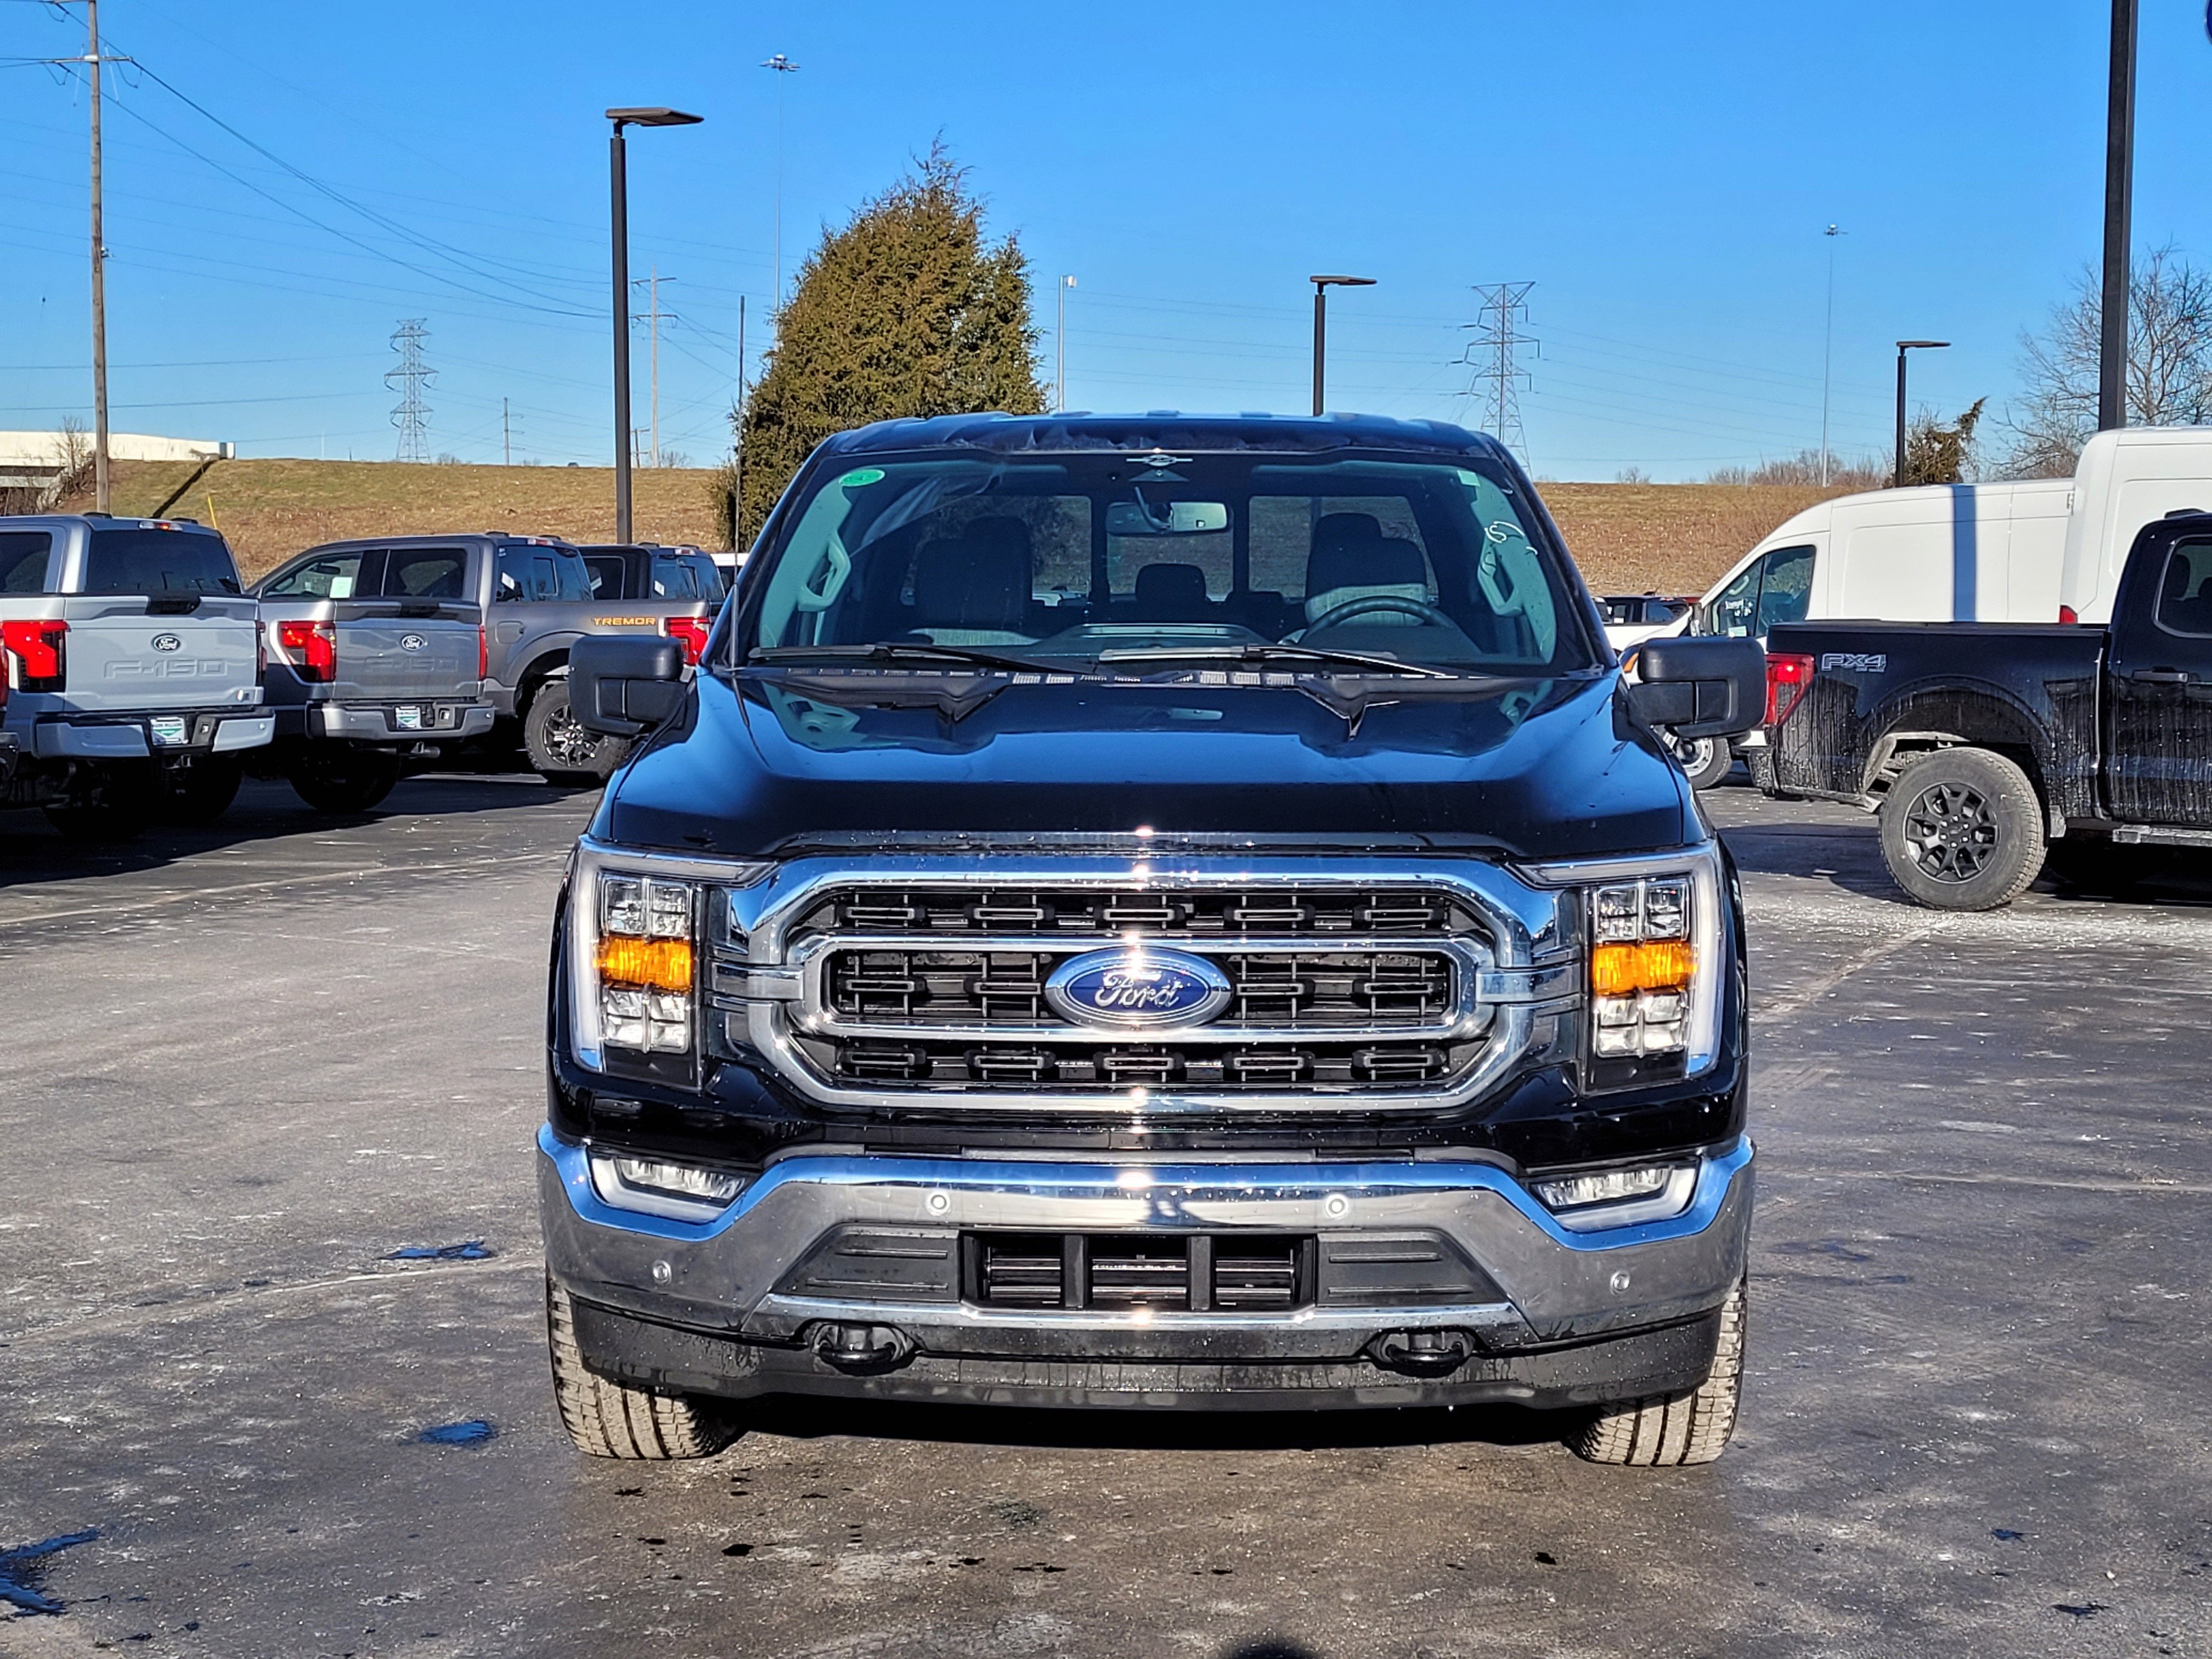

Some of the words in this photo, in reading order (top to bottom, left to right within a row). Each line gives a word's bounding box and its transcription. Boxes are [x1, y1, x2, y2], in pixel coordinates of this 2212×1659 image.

[594, 617, 656, 625] TREMOR
[159, 637, 177, 650] Ford
[104, 659, 227, 679] F-150
[1821, 653, 1886, 671] FX4
[1094, 969, 1183, 1008] Ford
